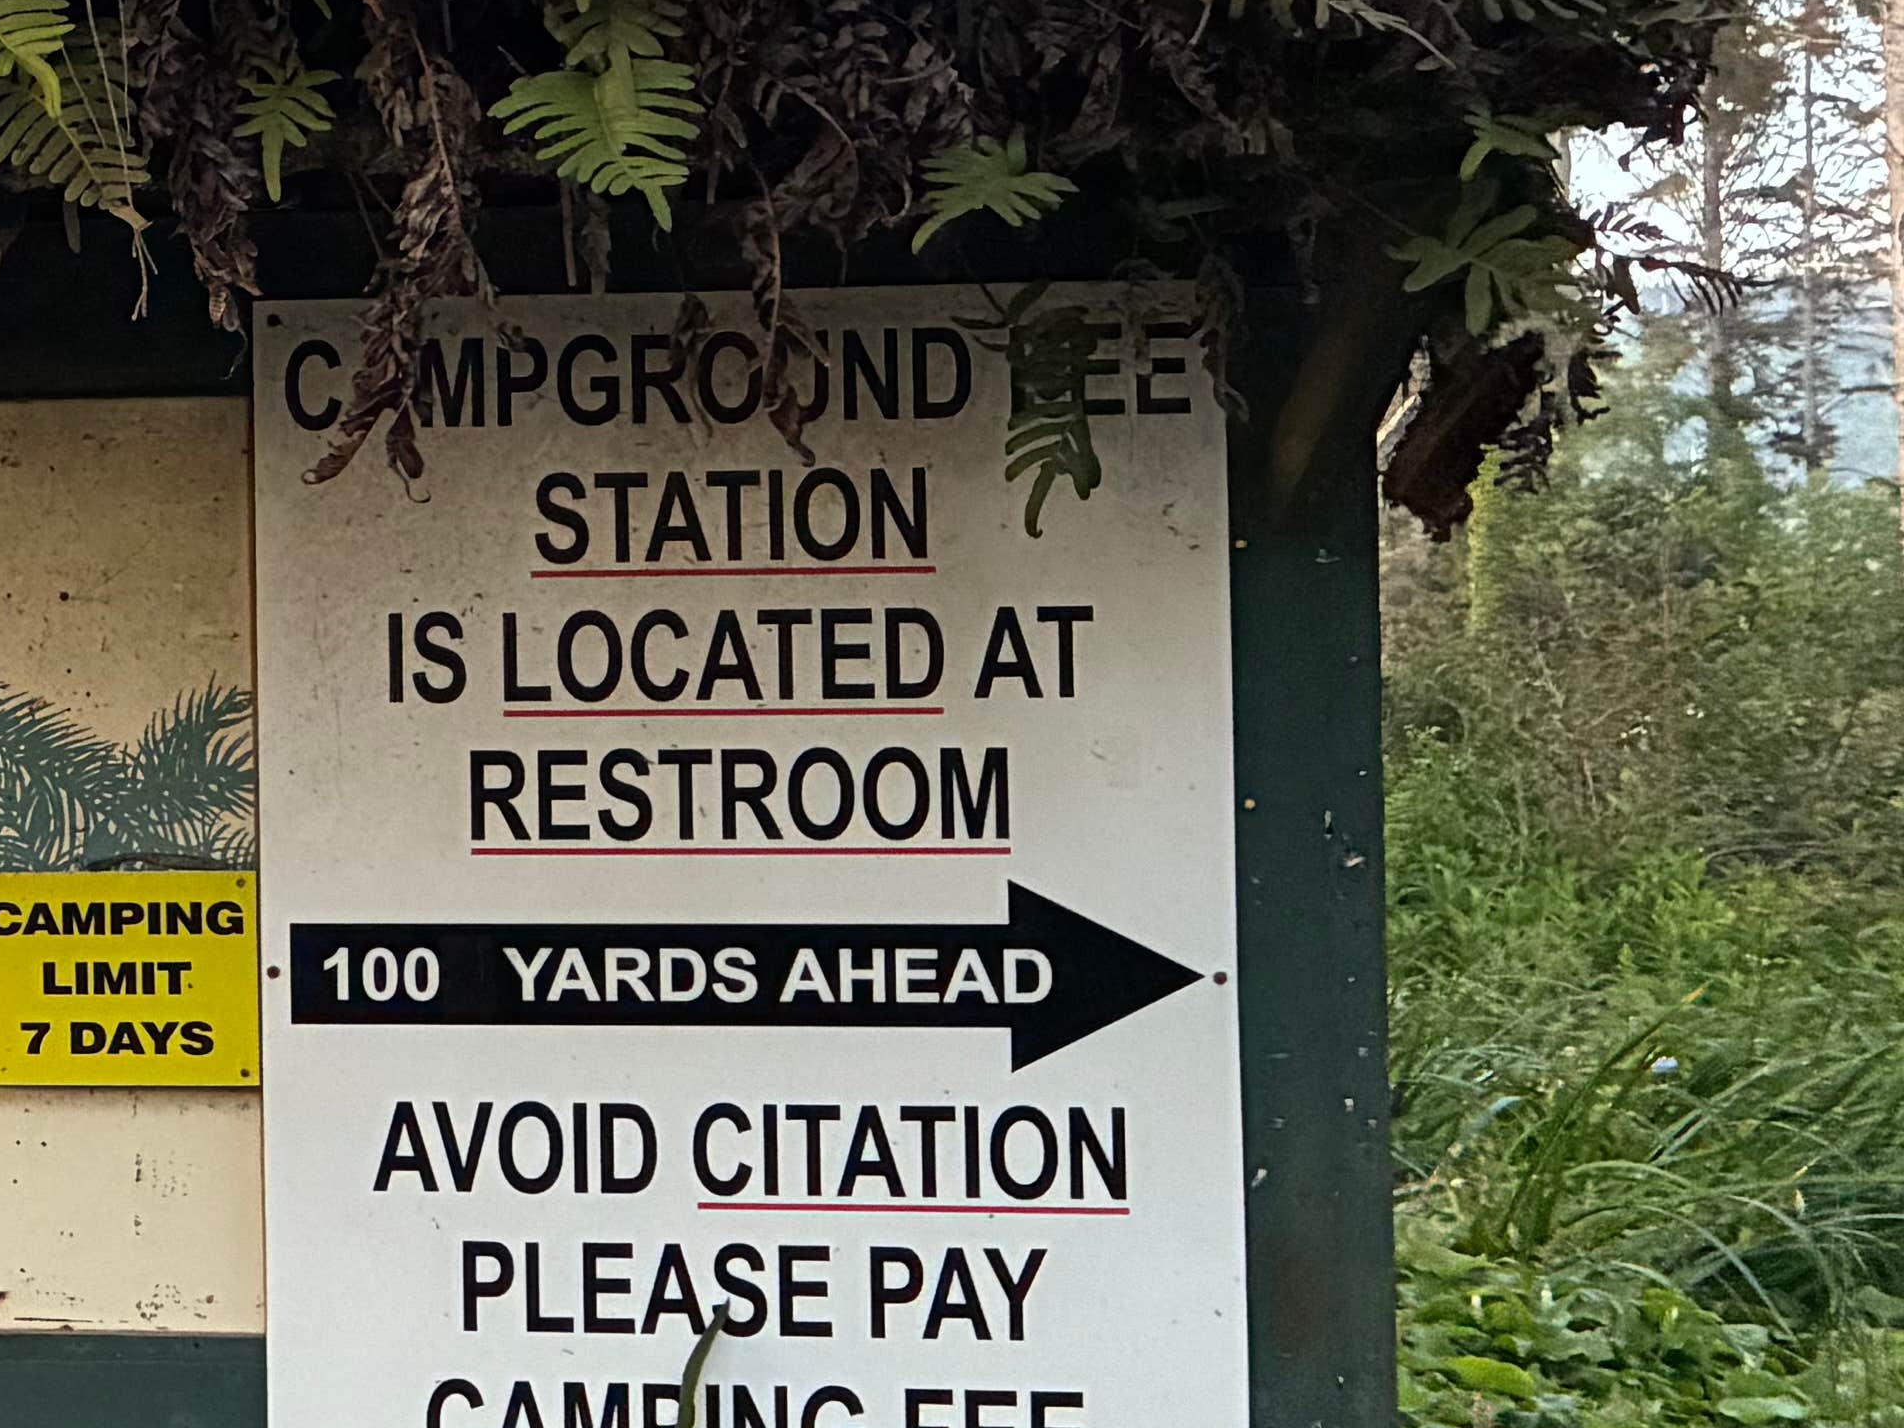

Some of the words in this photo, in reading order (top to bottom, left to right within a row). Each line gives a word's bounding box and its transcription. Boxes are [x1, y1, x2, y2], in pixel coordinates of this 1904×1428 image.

[285, 328, 972, 431] CMPGROUND
[1009, 321, 1193, 421] EE
[535, 466, 928, 565] STATION
[388, 612, 468, 704] IS
[502, 606, 945, 703] LOCATED
[974, 605, 1095, 699] AT
[470, 746, 1010, 842] RESTROOM
[42, 961, 193, 996] LIMIT
[323, 947, 440, 1002] 100
[503, 947, 758, 1003] YARDS
[779, 948, 1053, 1004] AHEAD
[20, 1022, 51, 1055] 7
[69, 1020, 215, 1056] DAYS
[373, 1101, 658, 1196] AVOID
[692, 1102, 1128, 1200] CITATION
[462, 1240, 833, 1338] PLEASE
[869, 1246, 1048, 1341] PAY
